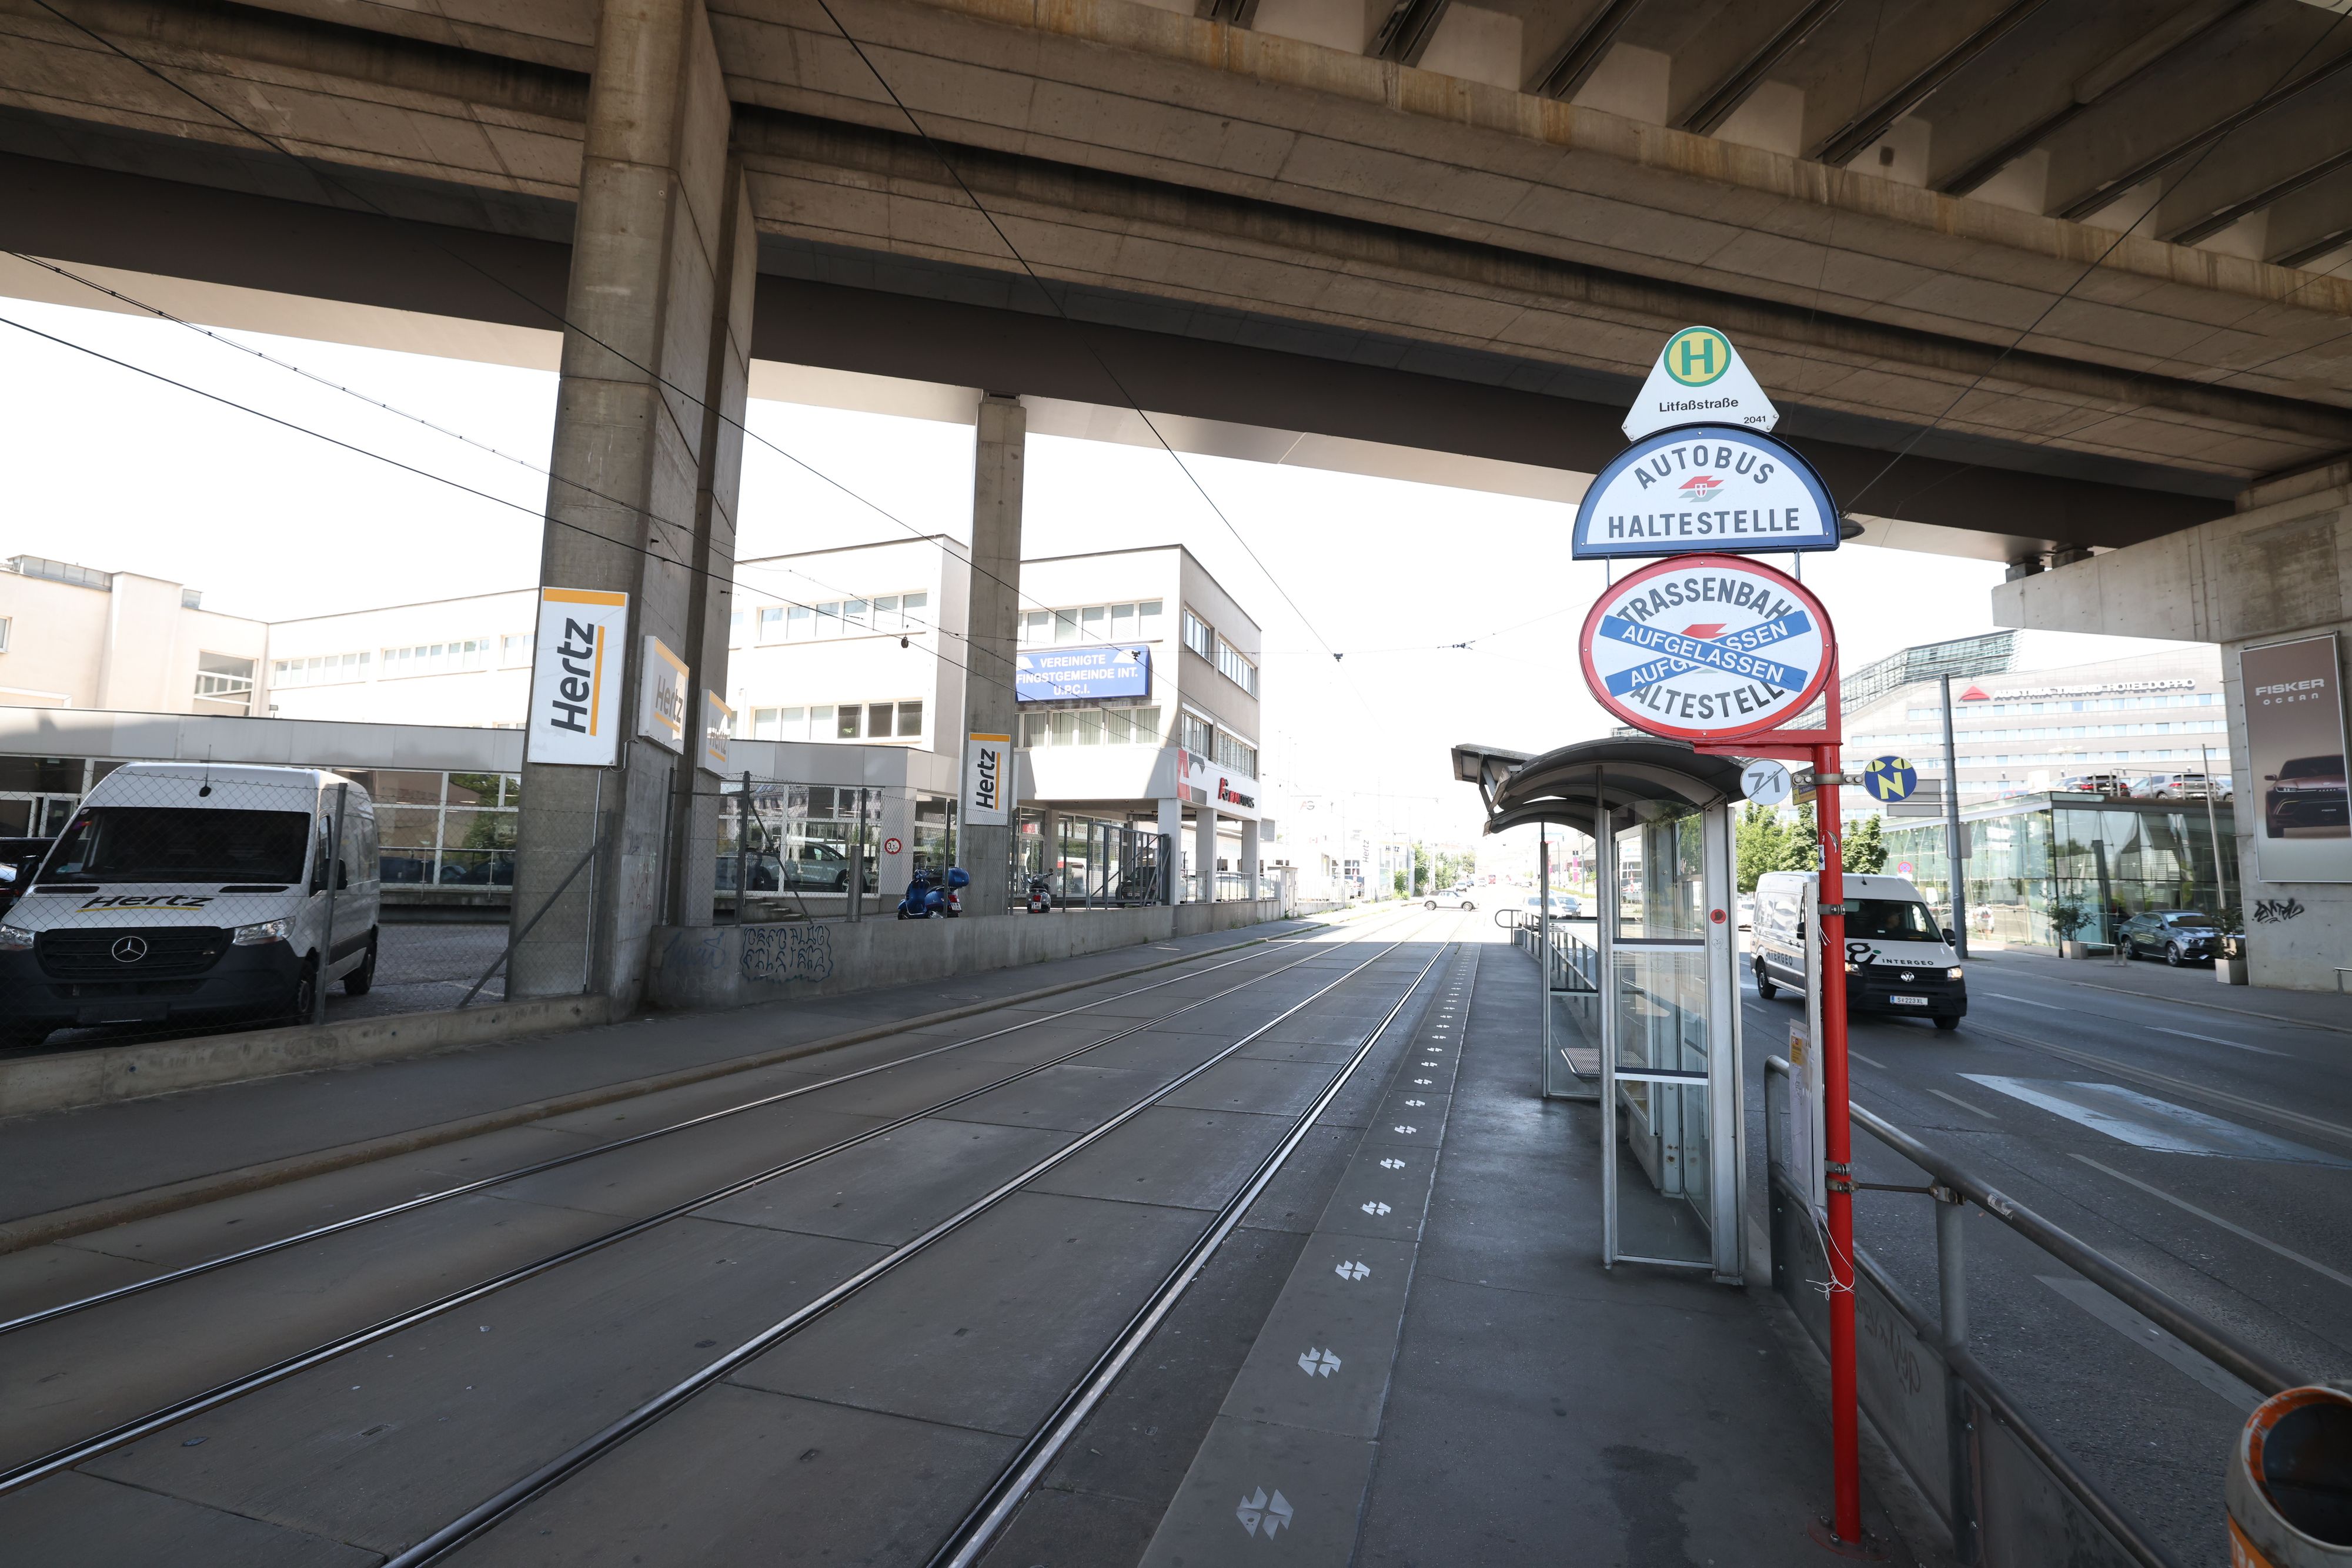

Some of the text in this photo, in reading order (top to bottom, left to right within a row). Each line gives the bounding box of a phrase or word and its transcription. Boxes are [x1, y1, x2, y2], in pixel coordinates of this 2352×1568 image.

[1681, 339, 1714, 376] H
[1659, 397, 1739, 413] Litfaßstraße
[1743, 415, 1766, 424] 2041
[1633, 444, 1775, 490] AUTOBUS
[1608, 507, 1800, 539] HALTESTELLE
[1616, 577, 1793, 624] TRASSENBAH
[1040, 654, 1106, 668] VEREINIGTE
[1622, 624, 1785, 683] AUFGELASSEN
[551, 617, 595, 734] Hertz
[1015, 667, 1138, 684] FINGSTGEMEINDE INT.
[2256, 678, 2324, 696] FISKER
[656, 674, 683, 724] Hertz
[1630, 682, 1786, 719] ALTESTELL
[976, 748, 996, 809] Hertz
[1877, 771, 1905, 800] N
[81, 895, 215, 909] Hertz
